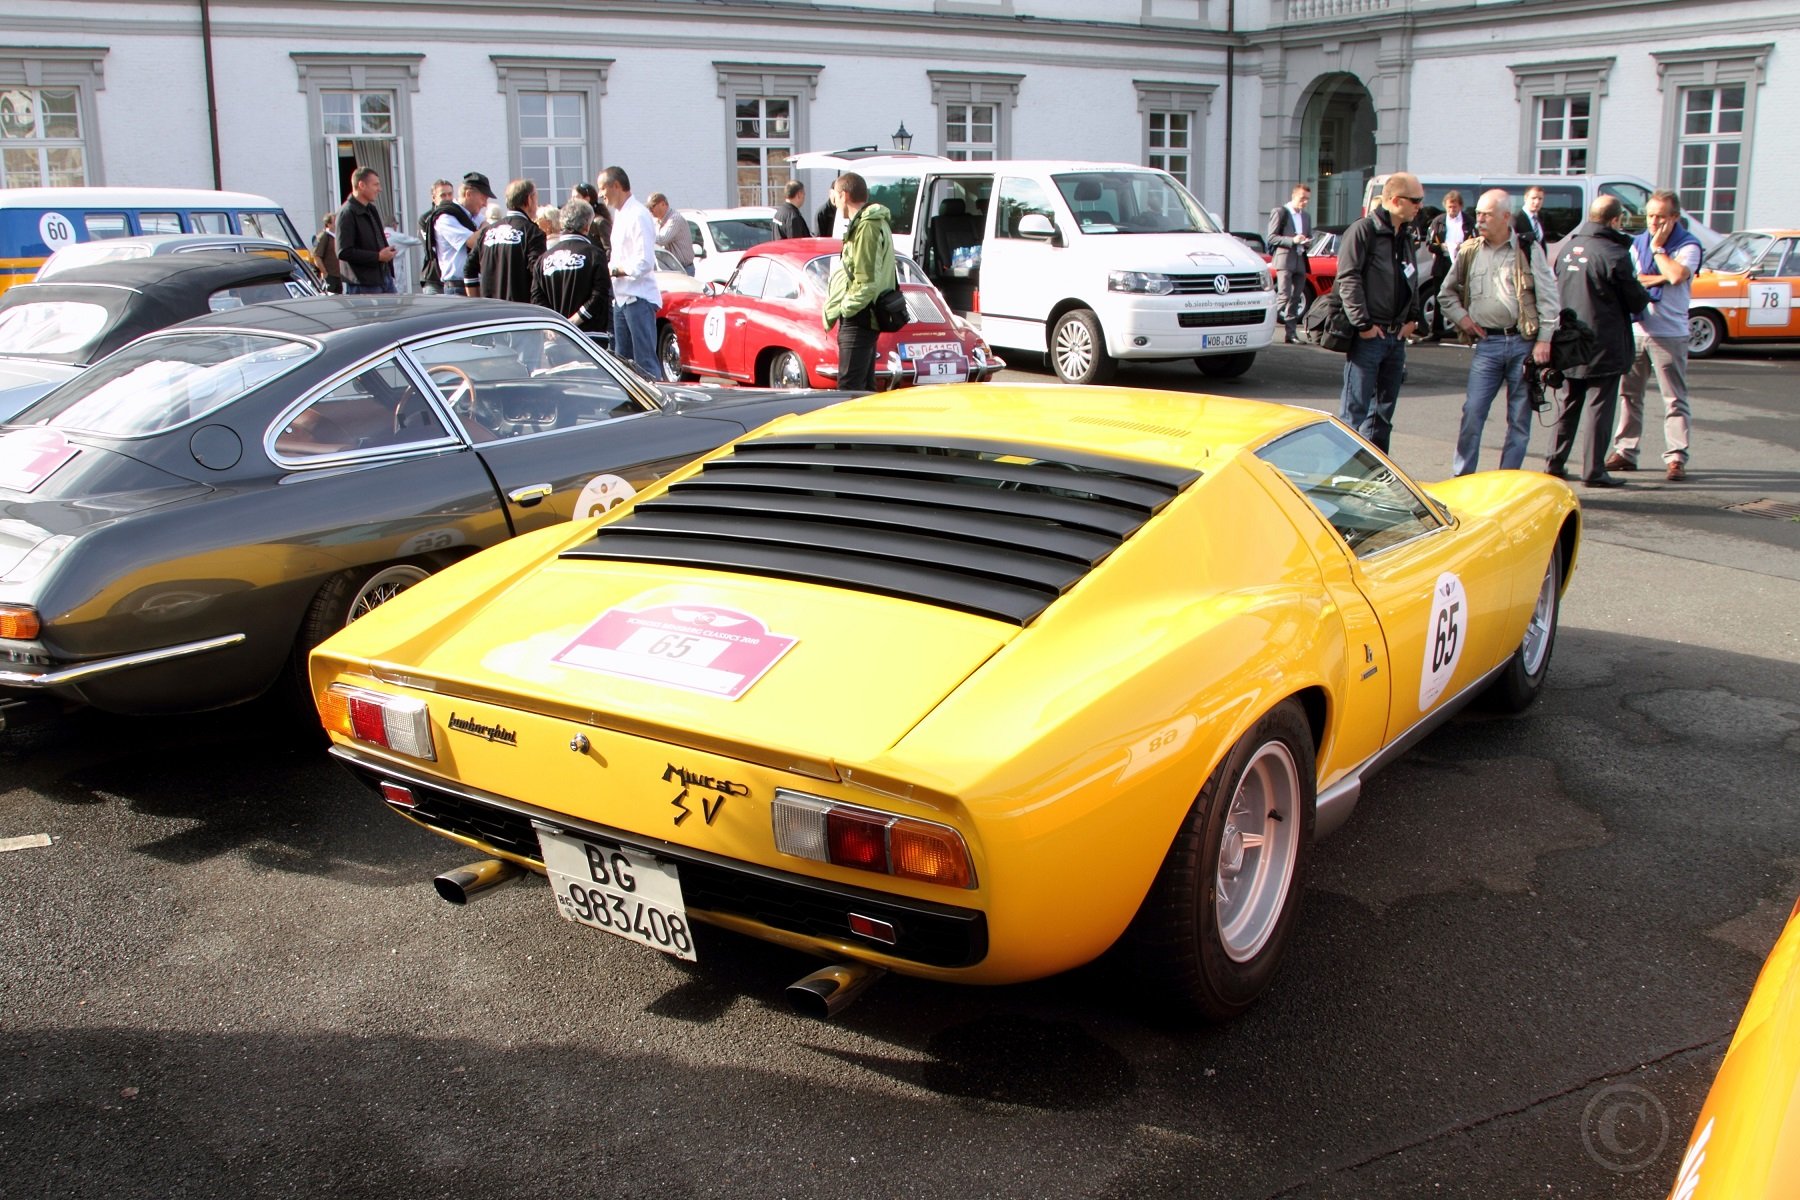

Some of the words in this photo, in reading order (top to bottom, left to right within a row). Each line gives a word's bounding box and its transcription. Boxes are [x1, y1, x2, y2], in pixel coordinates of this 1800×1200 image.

[47, 222, 68, 240] 60
[1761, 292, 1779, 308] 78
[709, 316, 720, 337] 51
[1207, 336, 1221, 347] WOB
[1224, 335, 1234, 346] CB
[1235, 334, 1247, 345] 455
[907, 345, 915, 357] S
[938, 363, 948, 375] 51
[702, 628, 740, 642] CLASSICS
[740, 635, 761, 645] 2010
[1432, 601, 1460, 673] 65
[648, 633, 700, 659] 65
[583, 843, 636, 893] BG
[568, 883, 691, 953] 983408
